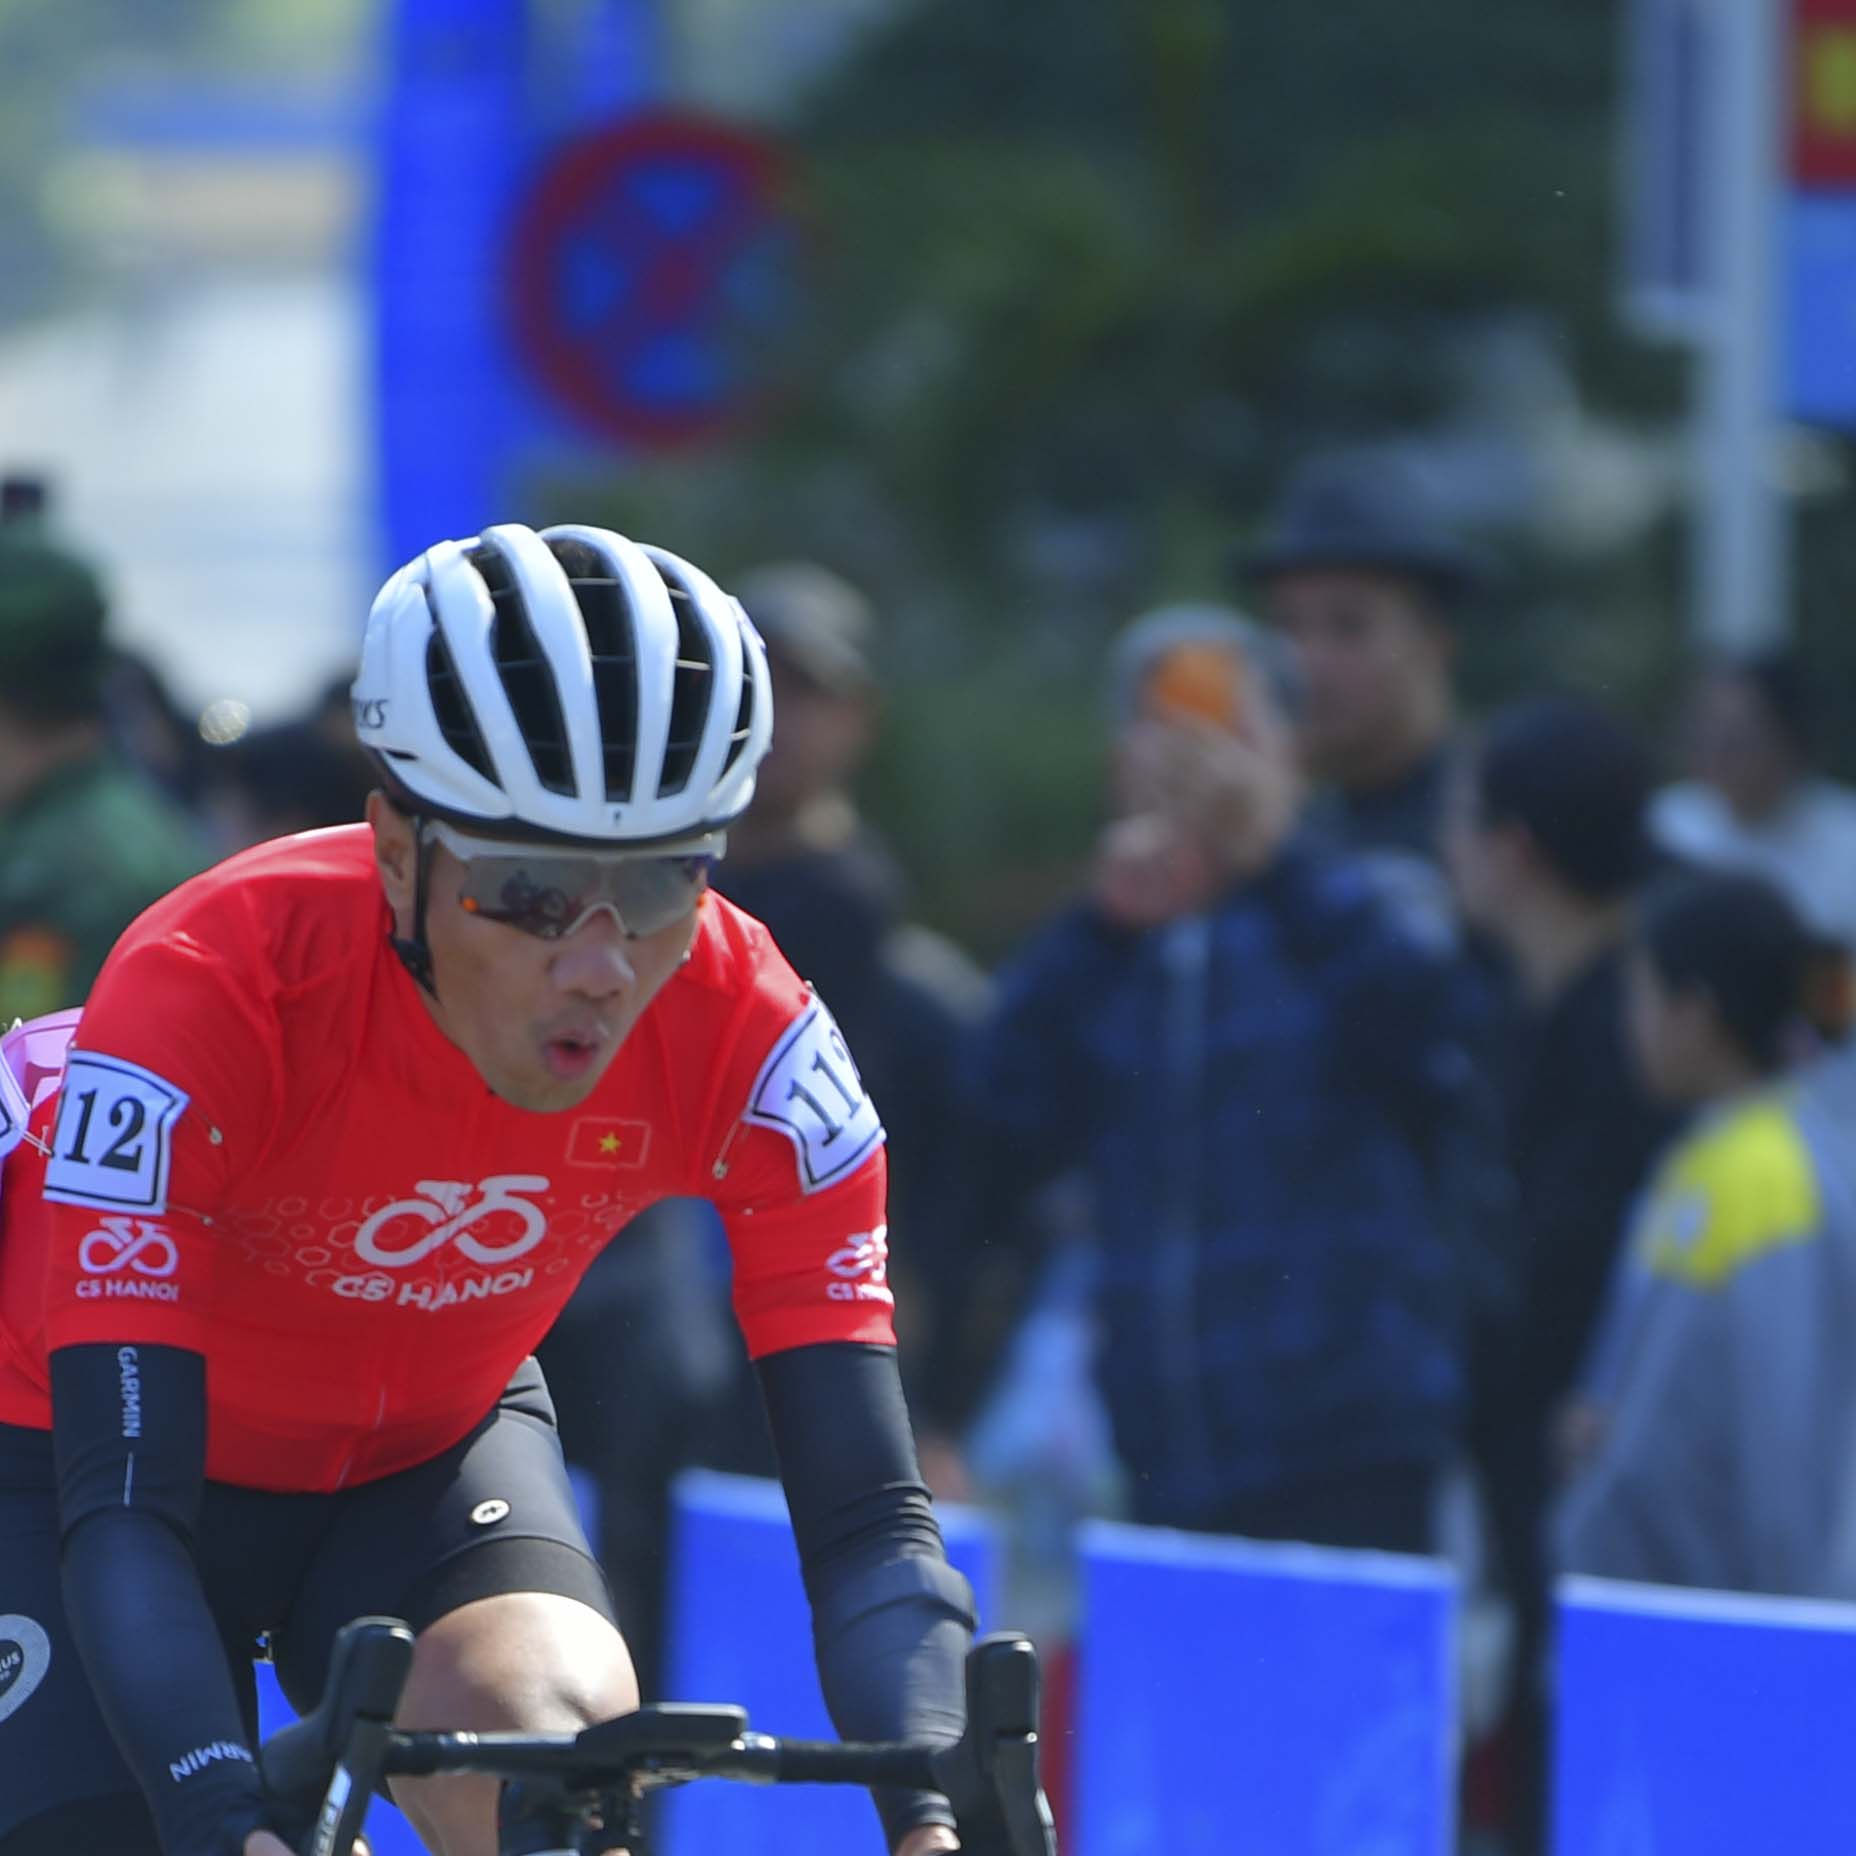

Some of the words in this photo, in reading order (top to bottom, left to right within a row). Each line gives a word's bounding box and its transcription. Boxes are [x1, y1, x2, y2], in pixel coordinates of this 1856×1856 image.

[105, 1279, 180, 1302] HANOI
[396, 1268, 534, 1313] HANOI
[117, 1346, 142, 1438] GARMIN
